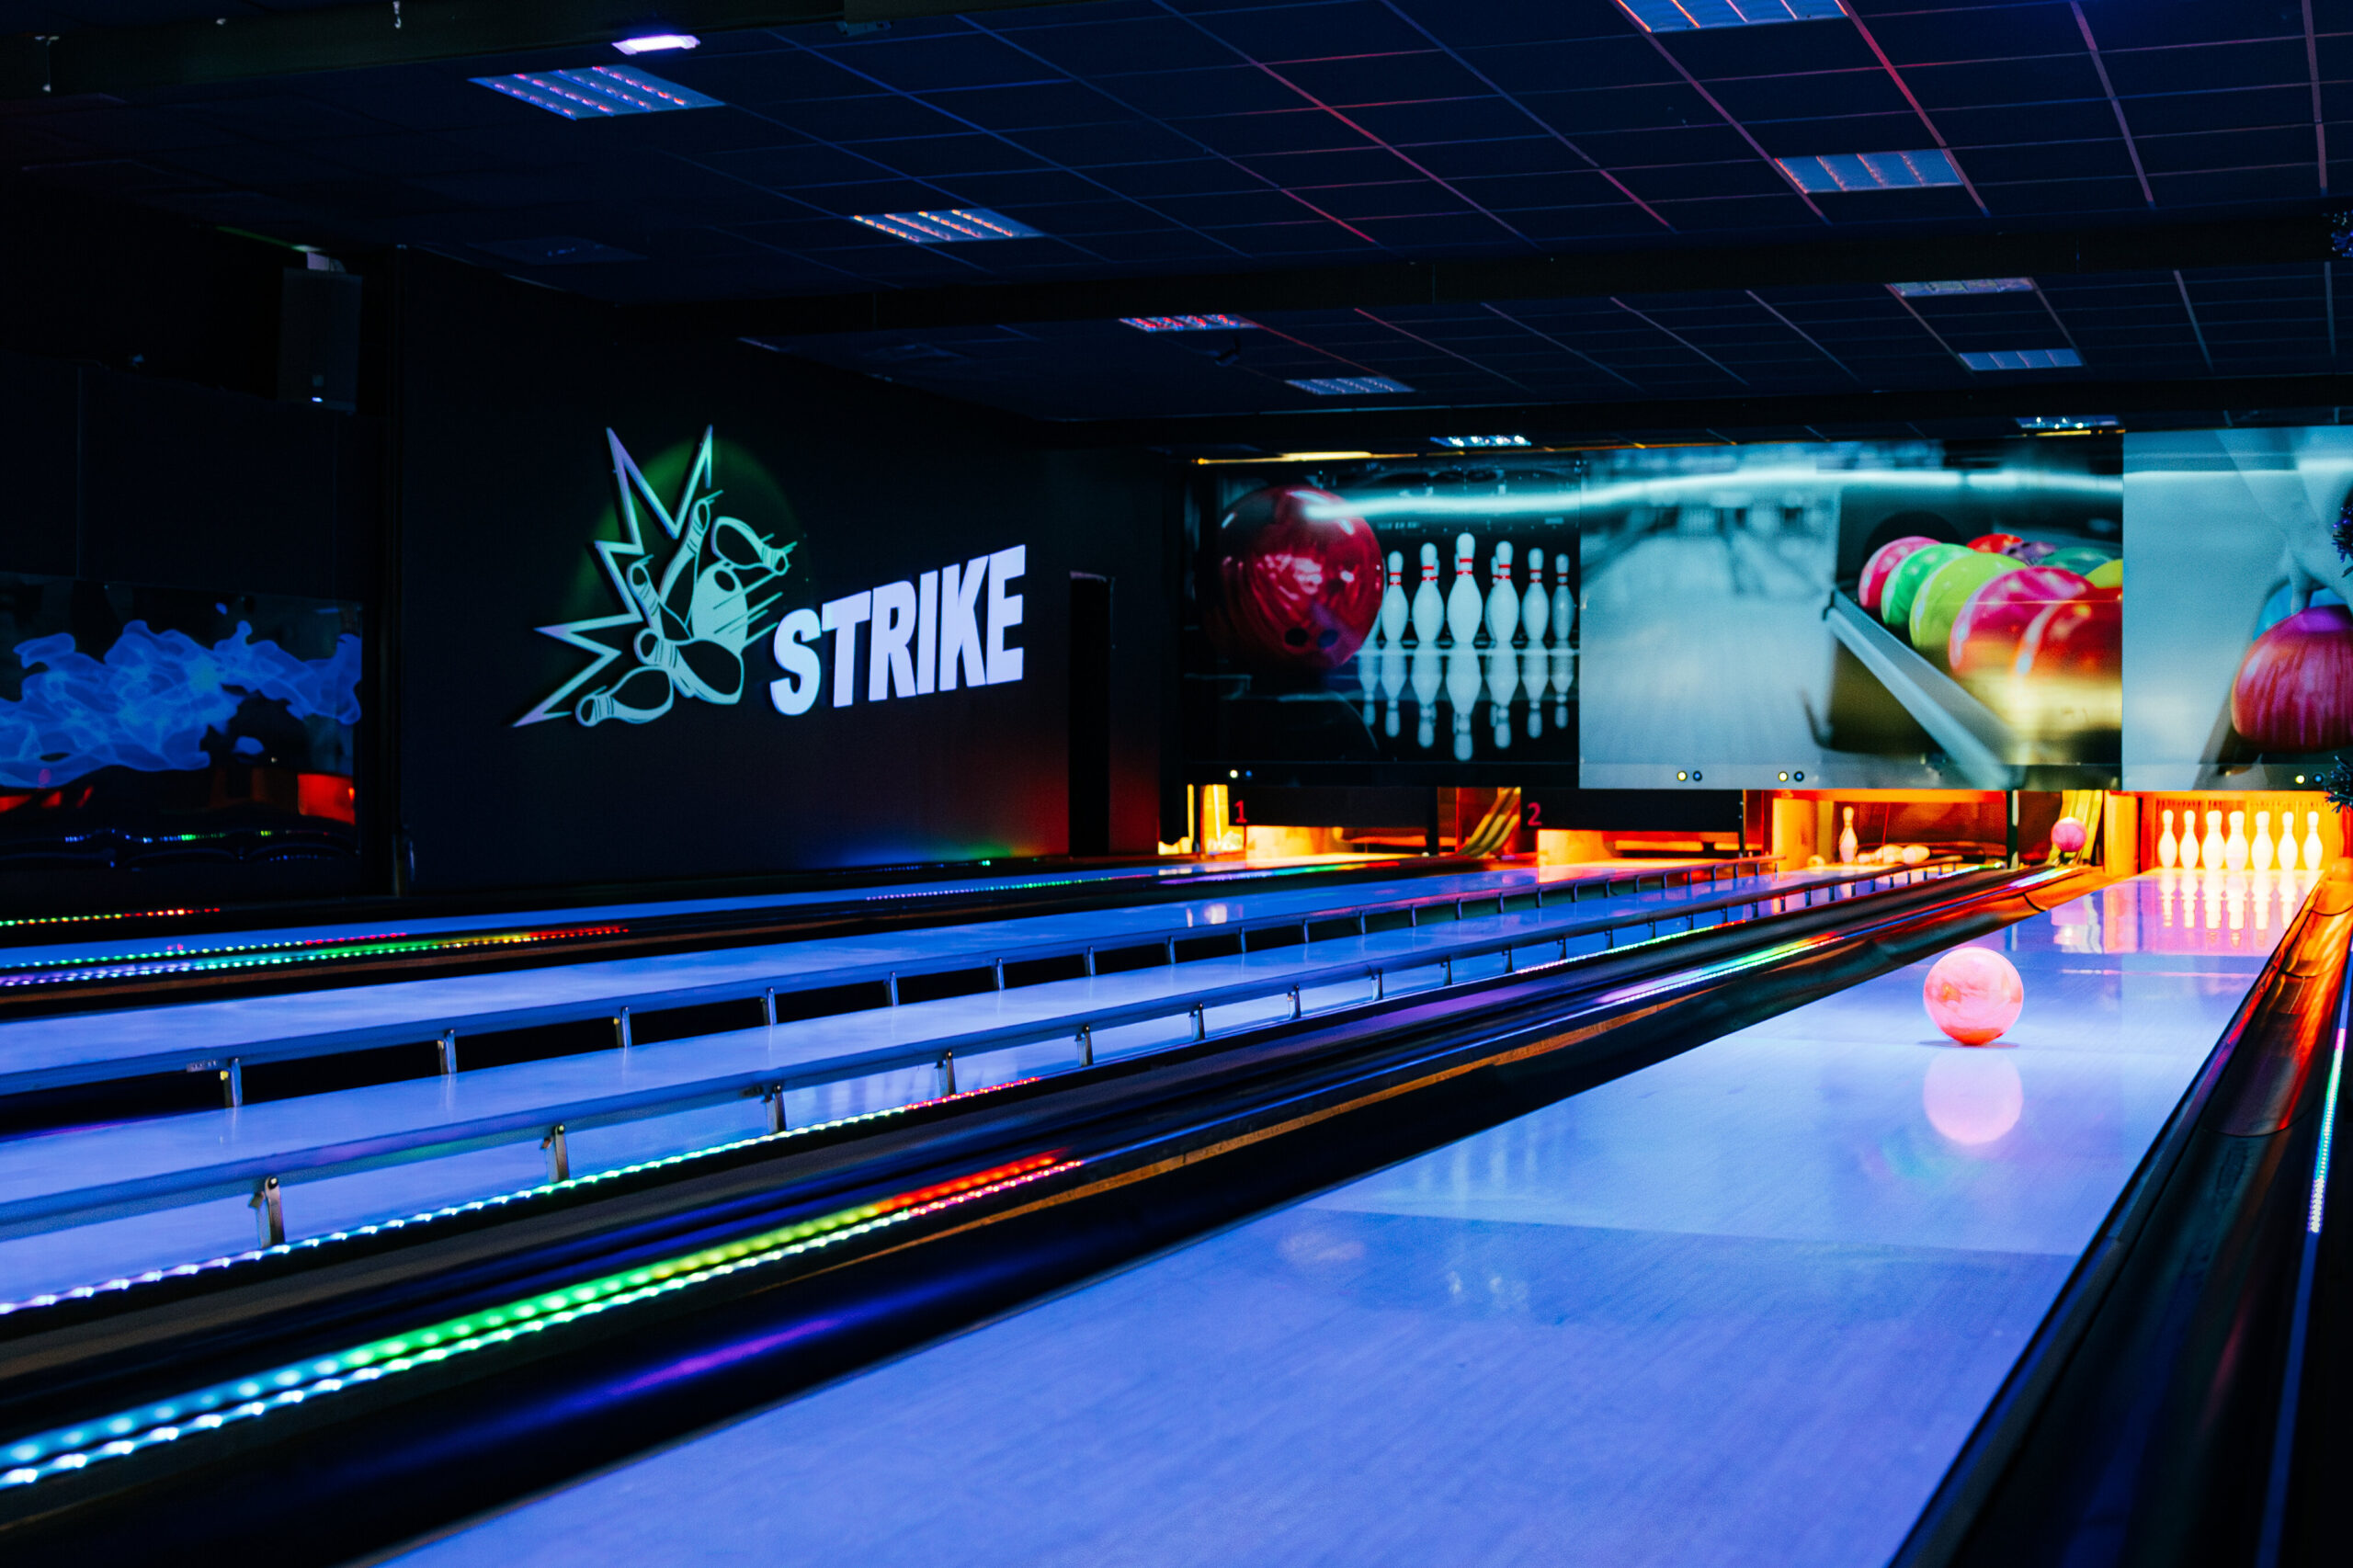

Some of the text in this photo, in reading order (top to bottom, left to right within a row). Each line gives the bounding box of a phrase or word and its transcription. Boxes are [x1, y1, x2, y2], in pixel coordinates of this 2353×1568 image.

[769, 544, 1026, 716] STRIKE
[1235, 800, 1247, 824] 1
[1528, 802, 1542, 826] 2
